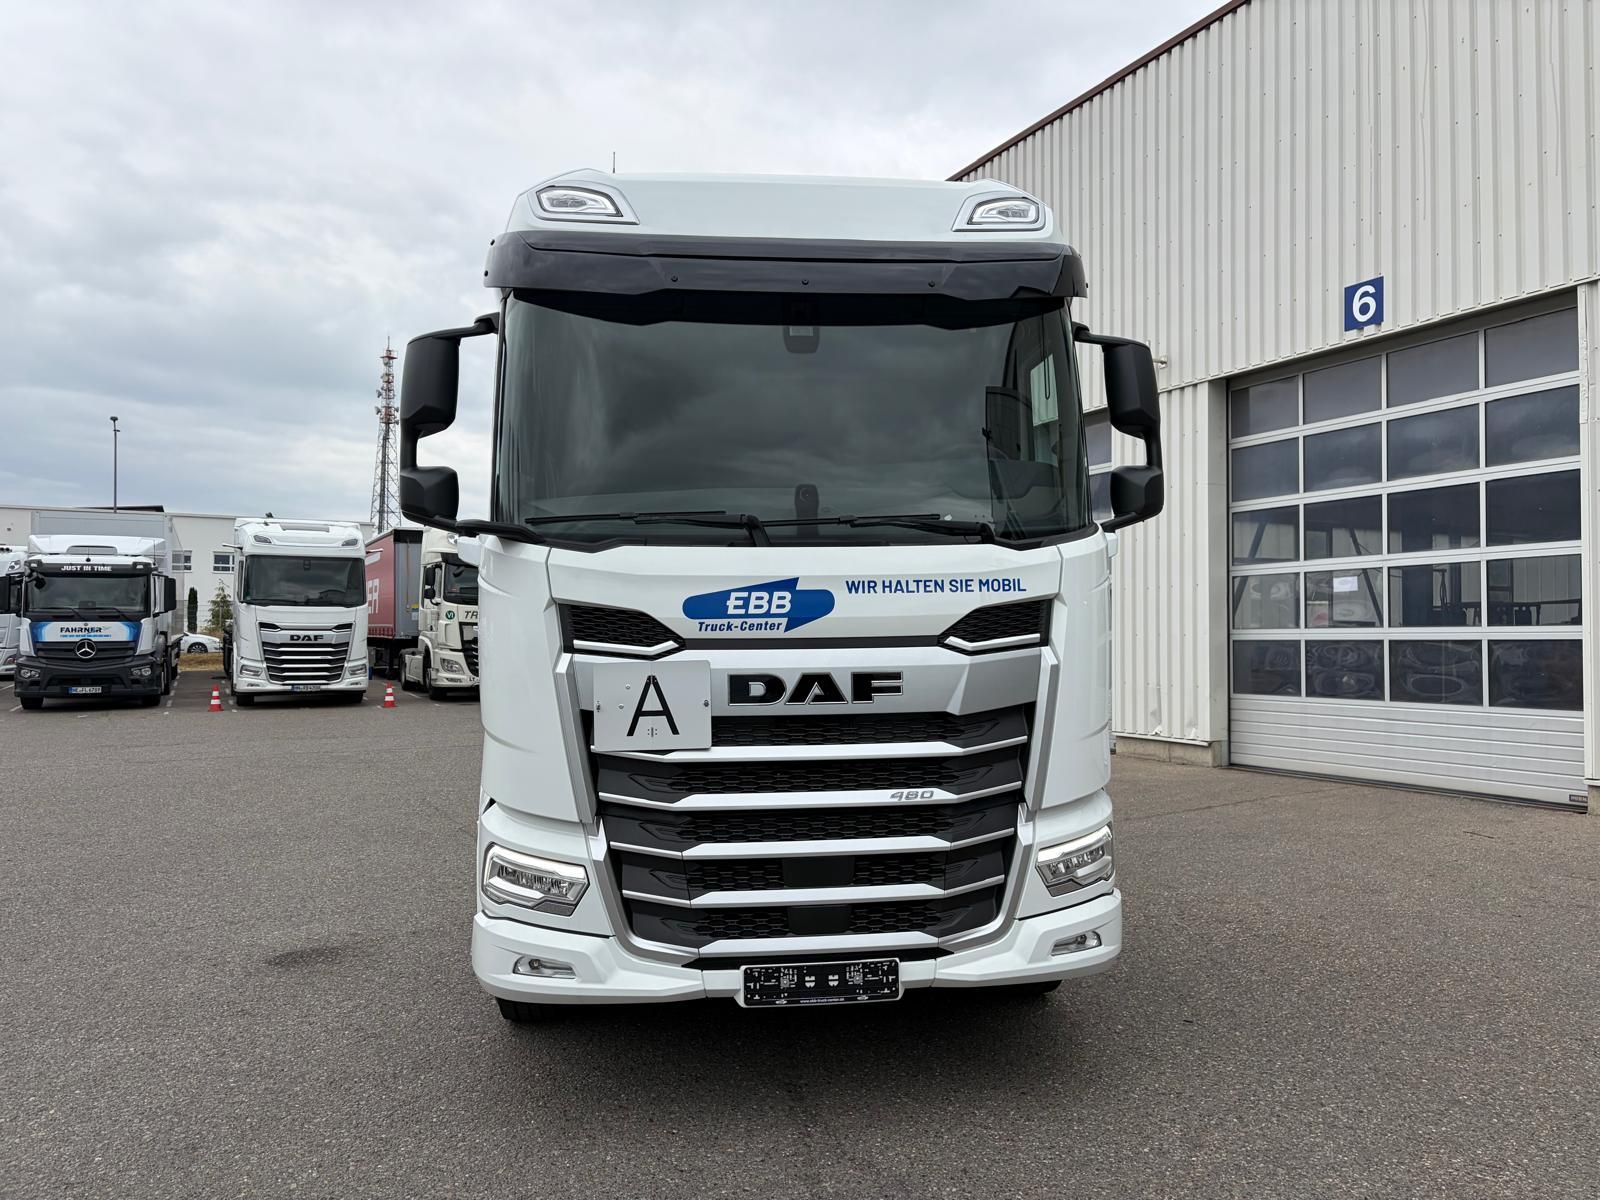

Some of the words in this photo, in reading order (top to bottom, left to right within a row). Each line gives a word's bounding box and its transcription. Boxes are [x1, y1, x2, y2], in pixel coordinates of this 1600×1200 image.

[1352, 284, 1377, 322] 6
[845, 580, 878, 594] WIR
[882, 579, 945, 593] HALTEN
[948, 578, 975, 593] SIE
[978, 577, 1027, 592] MOBIL
[726, 591, 792, 615] EBB
[698, 620, 783, 633] Truck-Center
[289, 634, 324, 642] DAF
[727, 671, 904, 706] DAF
[626, 674, 680, 737] A
[889, 790, 934, 801] 480
